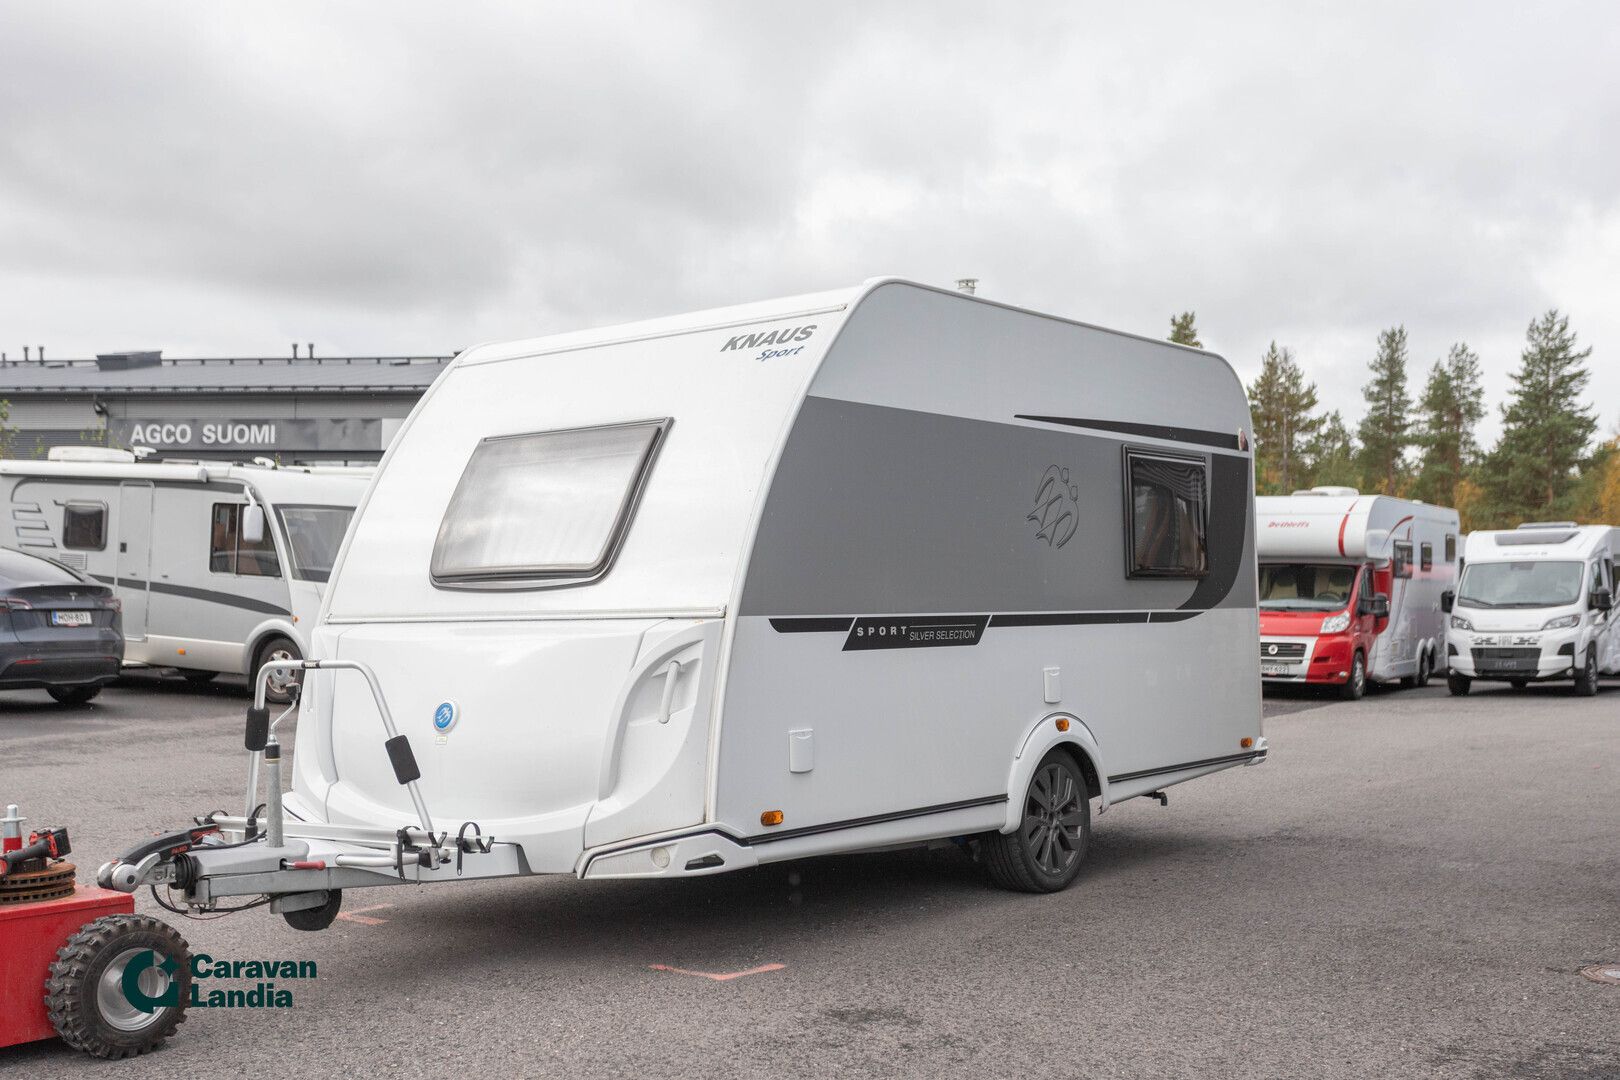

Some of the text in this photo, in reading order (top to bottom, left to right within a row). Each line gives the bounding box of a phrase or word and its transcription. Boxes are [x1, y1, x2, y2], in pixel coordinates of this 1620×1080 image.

[720, 324, 818, 352] KNAUS
[755, 345, 804, 362] Sport
[131, 423, 276, 444] AGCO SUOMI
[856, 626, 976, 641] SPORT SILVER SELECTION
